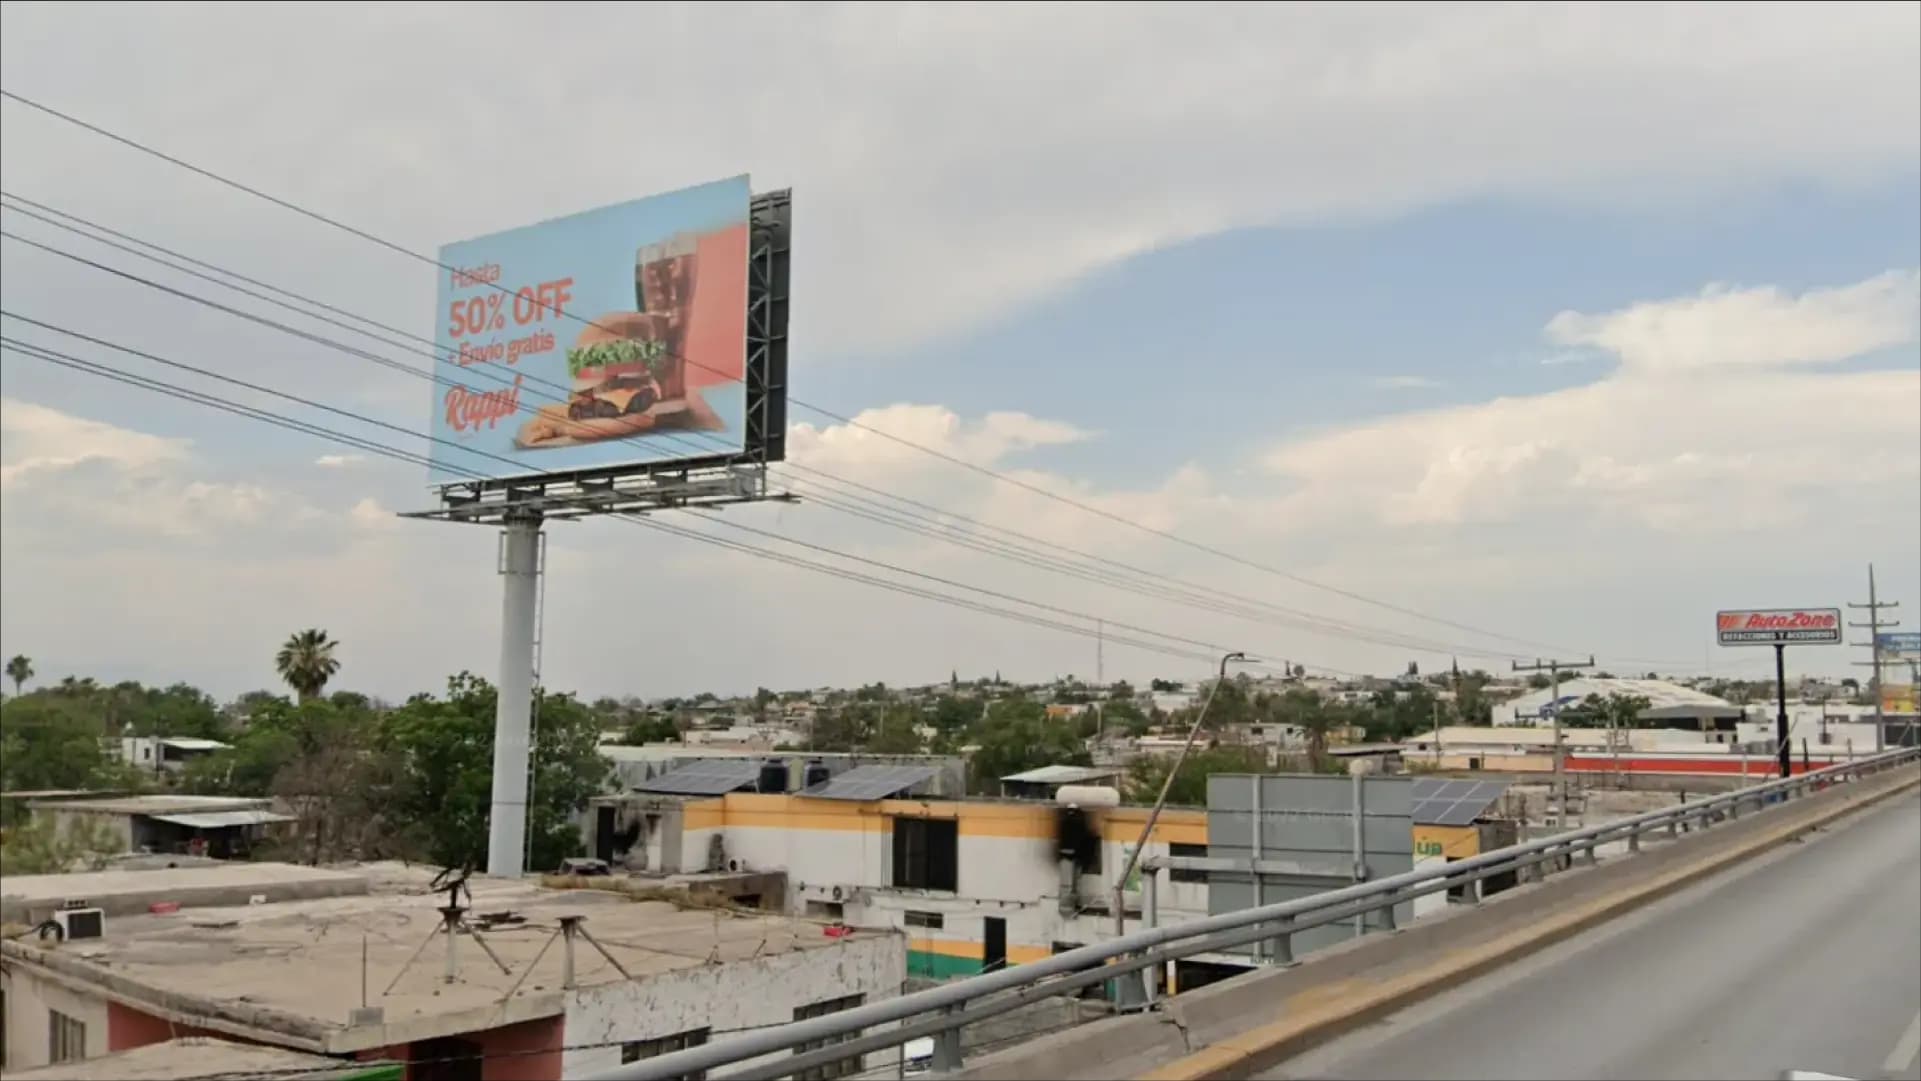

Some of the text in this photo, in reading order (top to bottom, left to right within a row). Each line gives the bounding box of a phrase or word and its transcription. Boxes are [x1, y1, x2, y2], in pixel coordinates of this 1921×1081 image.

[451, 264, 501, 290] Hasta
[449, 277, 573, 338] 50% OFF
[506, 328, 555, 364] gratis
[444, 374, 523, 431] Rappi
[1746, 612, 1835, 628] AutoZone
